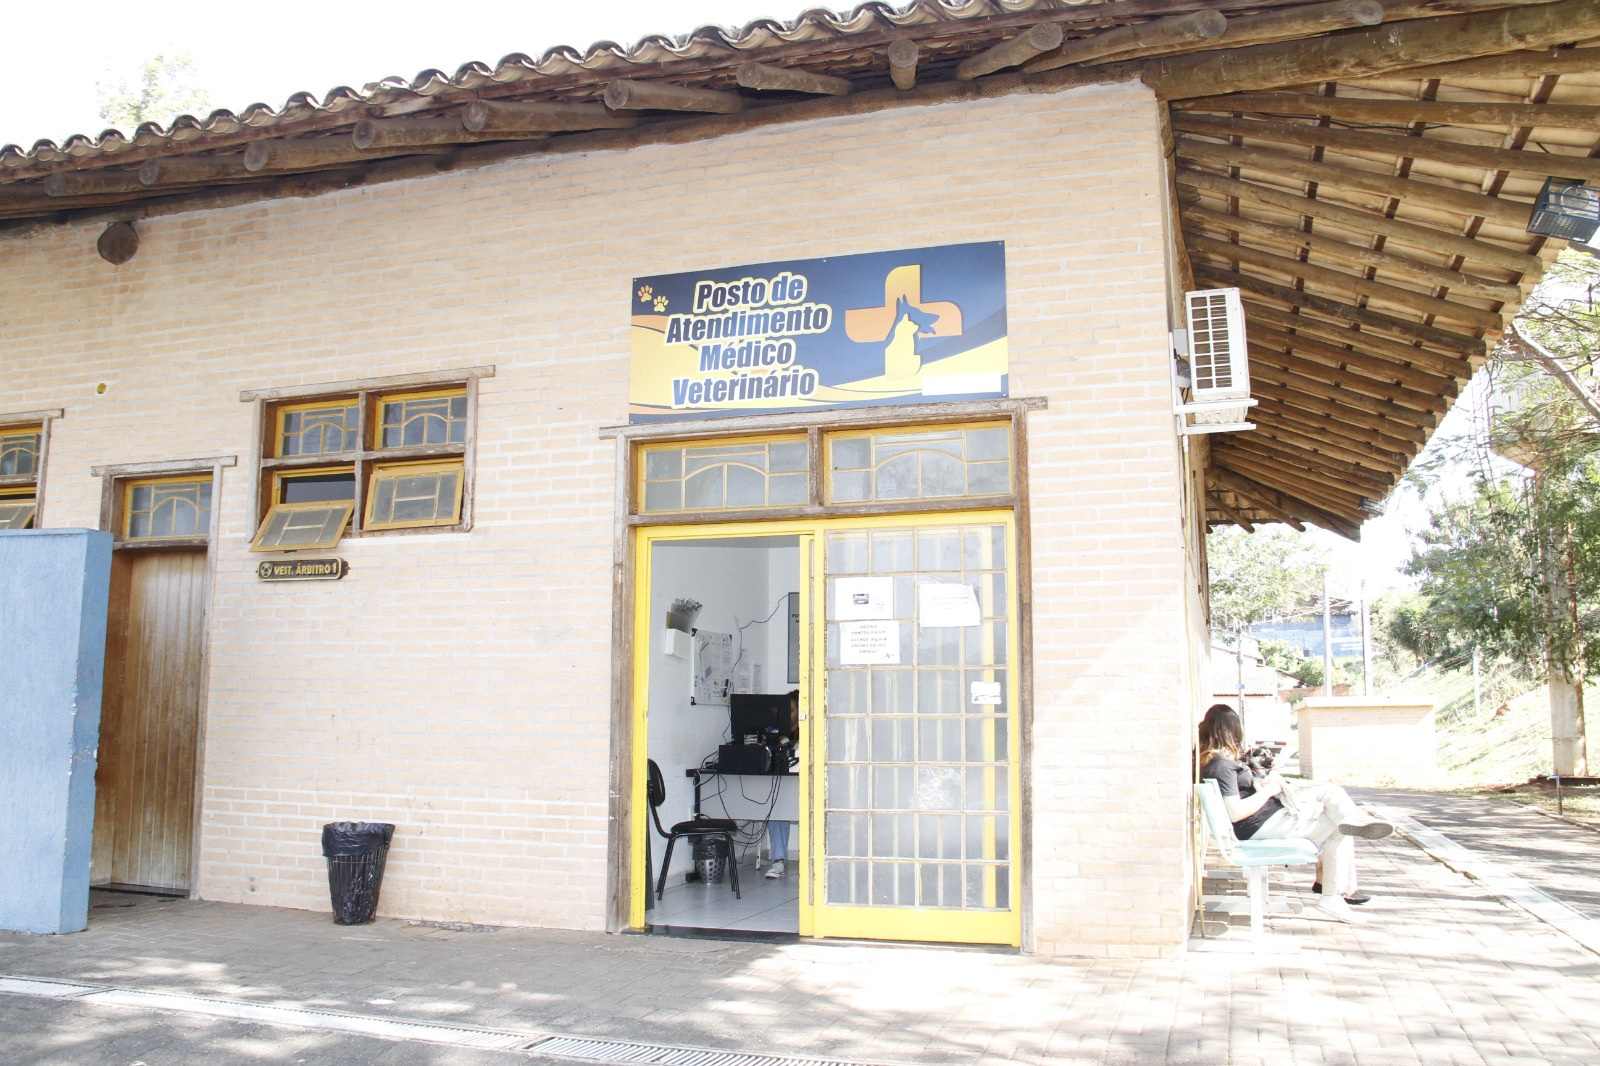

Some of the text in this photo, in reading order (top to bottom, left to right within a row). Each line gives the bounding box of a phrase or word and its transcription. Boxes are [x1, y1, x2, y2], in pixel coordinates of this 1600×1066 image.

[696, 274, 804, 311] Posto de
[666, 305, 828, 343] Atendimento
[699, 338, 793, 372] Médico
[672, 370, 815, 406] Veterinário
[274, 562, 337, 576] VEST. ÁRBITRO 1
